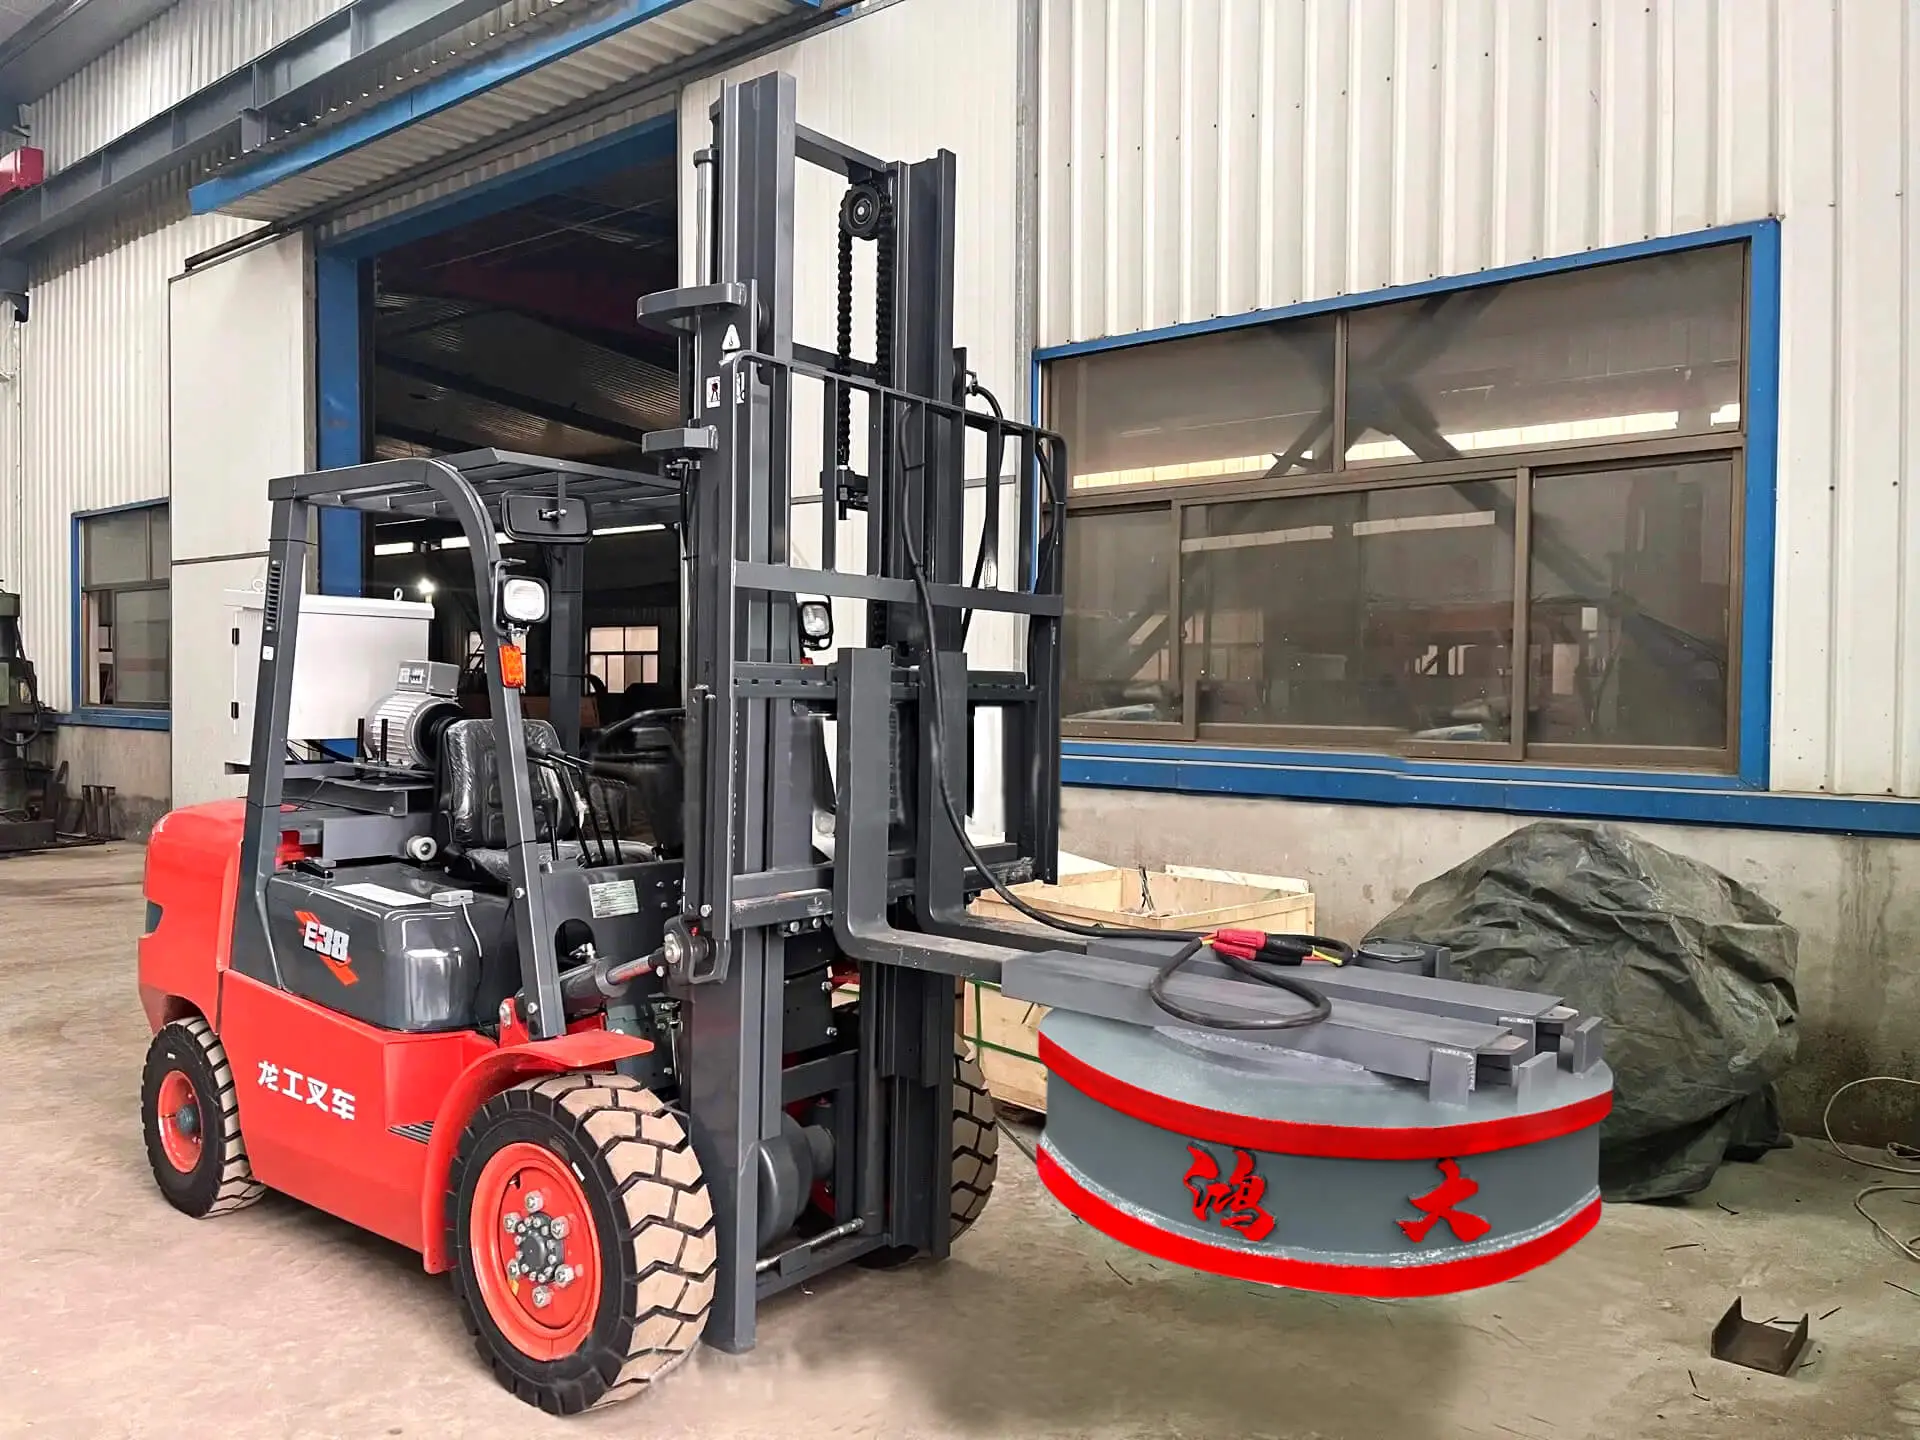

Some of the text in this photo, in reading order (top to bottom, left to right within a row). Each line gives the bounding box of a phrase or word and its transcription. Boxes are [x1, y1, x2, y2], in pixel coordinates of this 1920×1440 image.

[303, 920, 350, 962] E38
[257, 1060, 356, 1120] 龙工叉车
